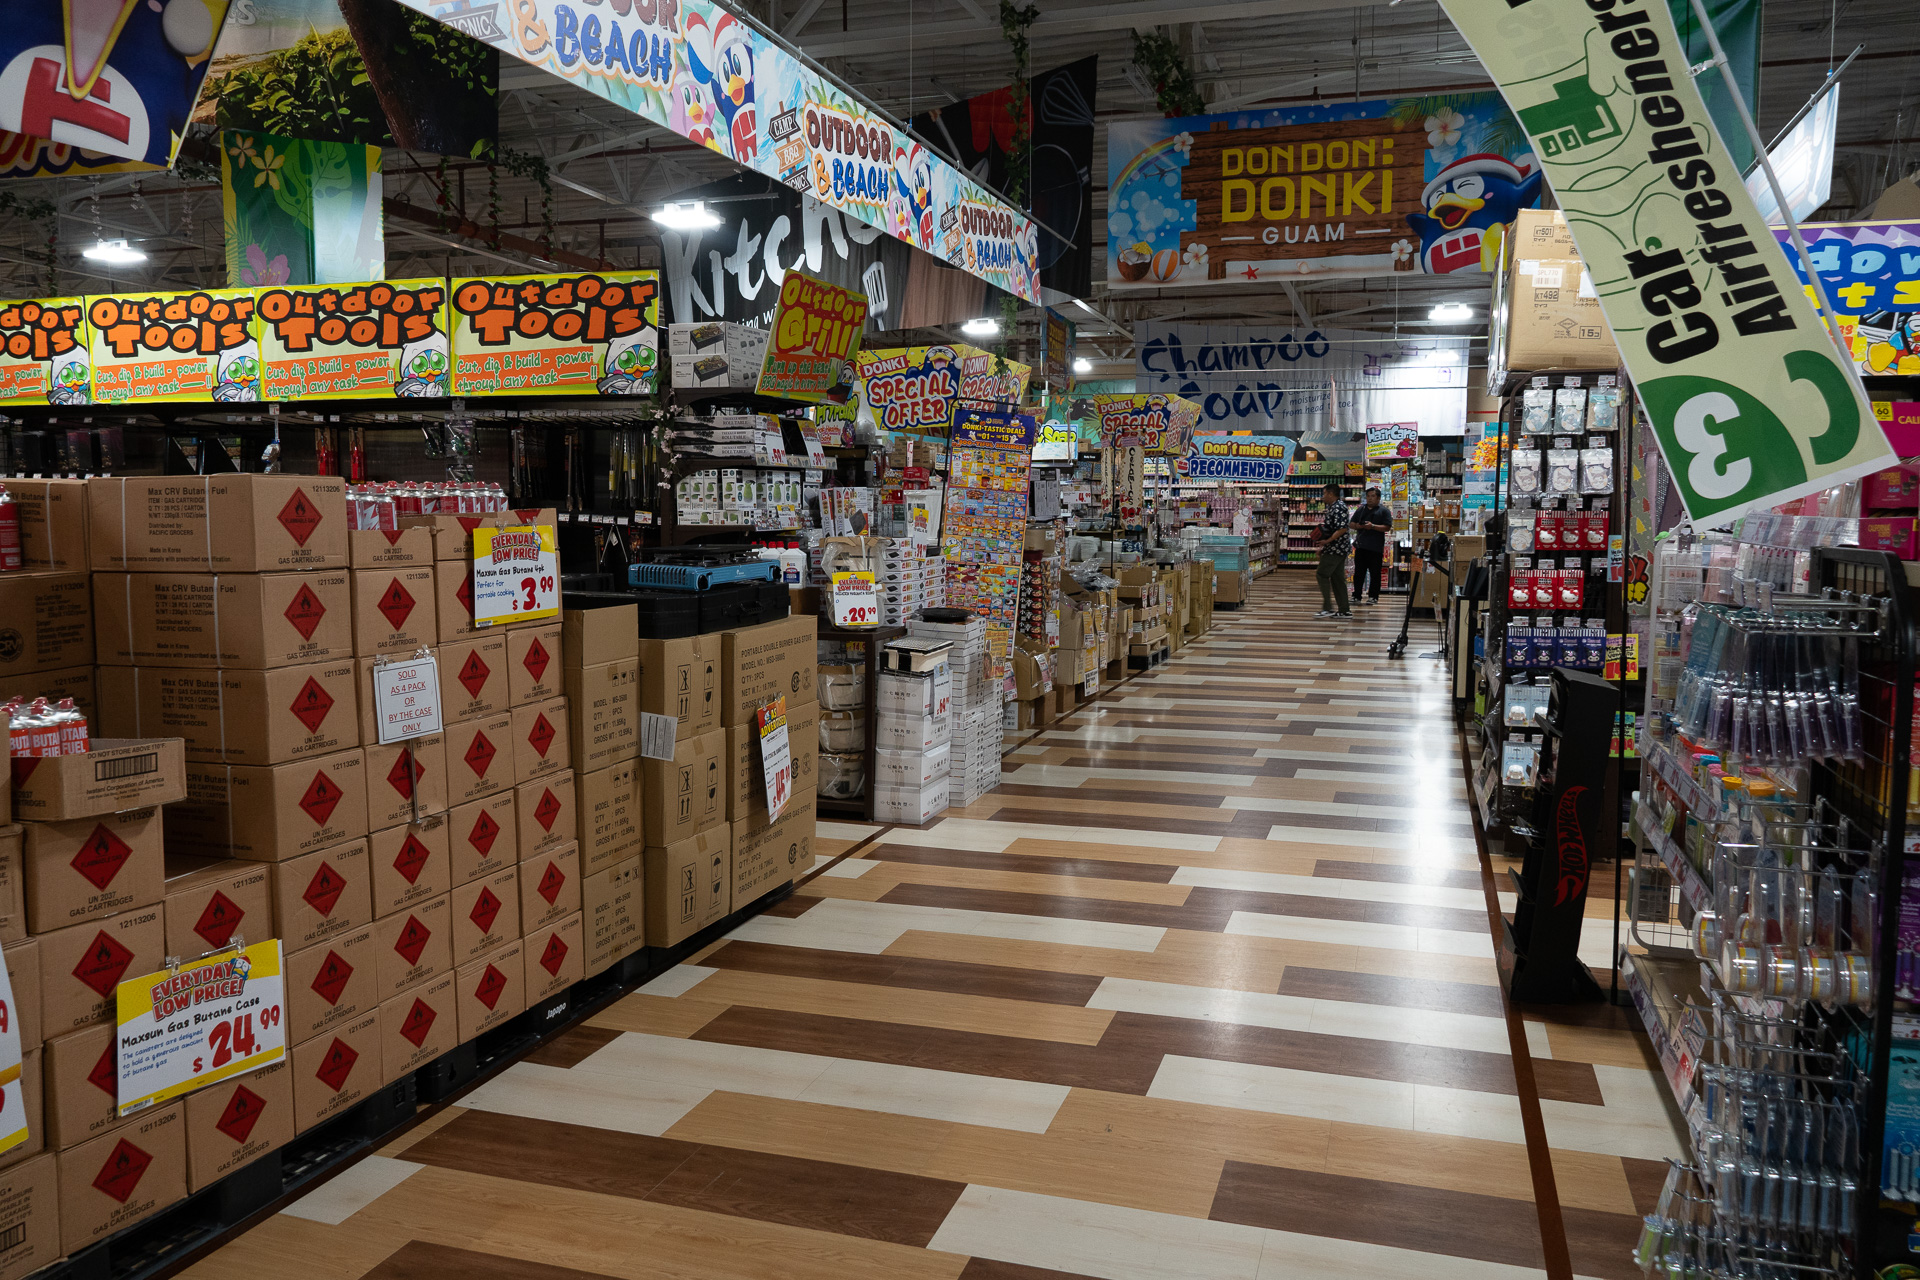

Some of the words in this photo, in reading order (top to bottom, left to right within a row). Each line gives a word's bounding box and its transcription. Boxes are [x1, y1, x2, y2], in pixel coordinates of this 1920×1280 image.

[554, 4, 673, 84] BEACH
[773, 114, 796, 136] CAMP
[805, 109, 893, 166] OUTDOOR
[783, 144, 800, 163] BBQ
[832, 157, 889, 203] BEACH
[1222, 169, 1393, 223] DONKI
[960, 204, 1013, 240] OUTDOOR
[1262, 222, 1345, 245] GUAM
[977, 240, 1012, 270] BEACH
[1537, 268, 1559, 276] SPL770
[260, 286, 441, 321] Outdoor
[457, 278, 654, 312] Outdoor
[782, 276, 868, 323] Outdoor
[1535, 290, 1559, 300] KT492
[91, 295, 255, 328] Outdoor
[1622, 247, 1720, 365] Car
[278, 312, 432, 350] Tools
[474, 307, 642, 343] Tools
[778, 308, 853, 357] Grill
[106, 321, 246, 355] Tools
[457, 358, 482, 374] Cut,
[484, 356, 501, 374] dig
[515, 352, 541, 368] build
[556, 350, 594, 367] power
[767, 355, 786, 374] Turn
[863, 356, 907, 376] DONKI
[962, 355, 989, 375] DONKI
[1140, 330, 1331, 383] Shampoo
[96, 369, 117, 384] Cut,
[118, 367, 132, 383] dig
[147, 362, 166, 378] build
[177, 361, 207, 378] power
[266, 366, 288, 381] Cut,
[289, 363, 305, 379] dig
[319, 359, 344, 376] build
[356, 355, 390, 371] power
[97, 384, 133, 401] through
[136, 384, 156, 398] any
[157, 380, 179, 394] task
[266, 382, 306, 399] through
[307, 381, 329, 396] any
[333, 375, 359, 389] task
[457, 376, 501, 392] through
[504, 373, 528, 389] any
[530, 369, 559, 385] task
[869, 369, 954, 404] SPECIAL
[1100, 400, 1133, 413] DONKI
[1178, 380, 1284, 427] Soap
[1289, 392, 1332, 406] moisturize
[886, 398, 948, 426] OFFER
[1282, 408, 1303, 419] from
[1305, 403, 1324, 414] head
[1876, 407, 1889, 416] 60
[1104, 411, 1165, 434] SPECIAL
[1203, 440, 1232, 456] Don't
[1238, 444, 1267, 457] miss
[1269, 443, 1284, 457] it!
[1189, 459, 1285, 480] RECOMMENDED
[147, 487, 163, 495] Max
[164, 487, 180, 496] CRV
[211, 486, 228, 495] Fuel
[312, 485, 341, 493] 12113206
[490, 532, 535, 550] EVERYDAY
[278, 557, 291, 565] GAS
[291, 555, 326, 564] CARTRIDGES
[492, 549, 511, 565] LOW
[512, 546, 540, 562] PRICE!
[317, 578, 345, 586] 12113206
[476, 568, 498, 578] Maxsun
[498, 567, 511, 576] Gas
[513, 566, 534, 575] Butane
[838, 578, 871, 586] EVERYDAY
[154, 584, 170, 593] Max
[171, 584, 188, 593] CRV
[220, 584, 237, 593] Fuel
[497, 589, 516, 598] cooking
[323, 667, 352, 679] 12113206
[397, 669, 417, 680] SOLD
[390, 685, 400, 695] AS
[401, 684, 407, 692] 4
[407, 680, 426, 691] PACK
[404, 696, 416, 706] OR
[388, 713, 398, 722] BY
[399, 710, 414, 720] THE
[414, 706, 433, 717] CASE
[401, 721, 422, 733] ONLY
[87, 752, 97, 760] DO
[97, 750, 111, 759] NOT
[111, 747, 132, 756] STORE
[131, 745, 151, 753] ABOVE
[291, 745, 304, 755] GAS
[304, 739, 338, 752] CARTRIDGES
[118, 810, 156, 825] 12113206
[299, 839, 313, 850] GAS
[313, 830, 346, 845] CARTRIDGES
[231, 873, 265, 890] 12113206
[69, 906, 86, 918] GAS
[86, 894, 134, 915] CARTRIDGES
[118, 913, 157, 930] 12113206
[342, 931, 370, 948] 12113206
[150, 961, 235, 1004] EVERYDAY
[152, 991, 192, 1022] LOW
[193, 978, 245, 1006] PRICE!
[121, 1028, 164, 1049] Maxsun
[167, 1019, 190, 1034] Gas
[194, 1006, 233, 1026] Butane
[235, 996, 261, 1012] Case
[122, 1052, 134, 1061] The
[134, 1041, 164, 1056] canisters
[165, 1037, 177, 1045] are
[178, 1027, 204, 1043] designed
[131, 1057, 144, 1068] hold
[151, 1045, 180, 1063] generous
[181, 1037, 204, 1049] amount
[122, 1070, 132, 1080] of
[132, 1062, 154, 1076] butane
[155, 1058, 168, 1070] gas
[139, 1111, 178, 1135] 12113206
[92, 1224, 108, 1236] GAS
[107, 1200, 156, 1232] CARTRIDGES
